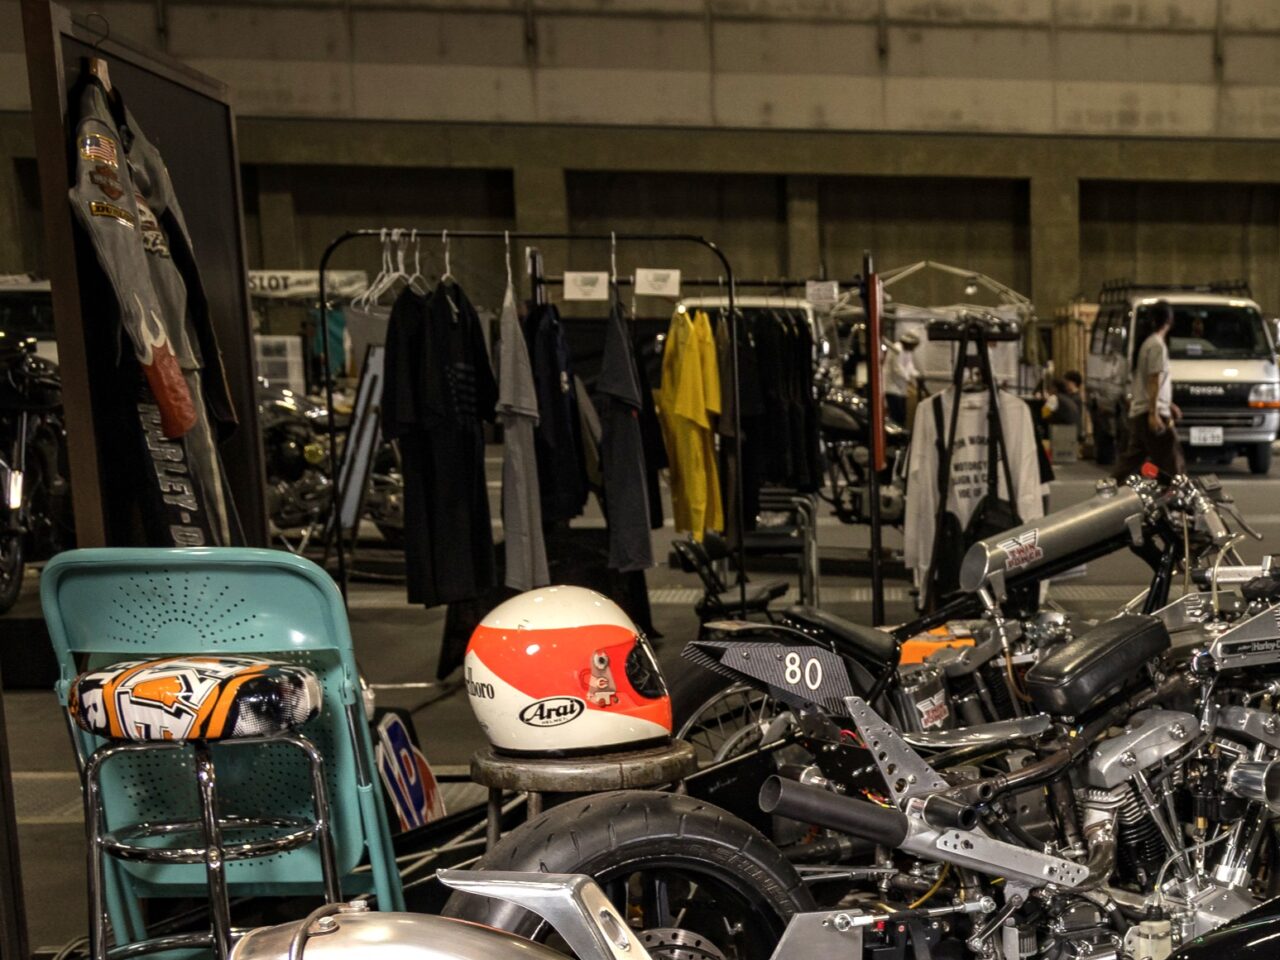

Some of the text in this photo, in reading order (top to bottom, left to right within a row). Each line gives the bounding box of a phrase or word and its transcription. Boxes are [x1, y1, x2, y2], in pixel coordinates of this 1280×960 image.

[1189, 385, 1224, 396] TOYOTA
[785, 652, 822, 690] 80
[526, 698, 576, 722] Arai
